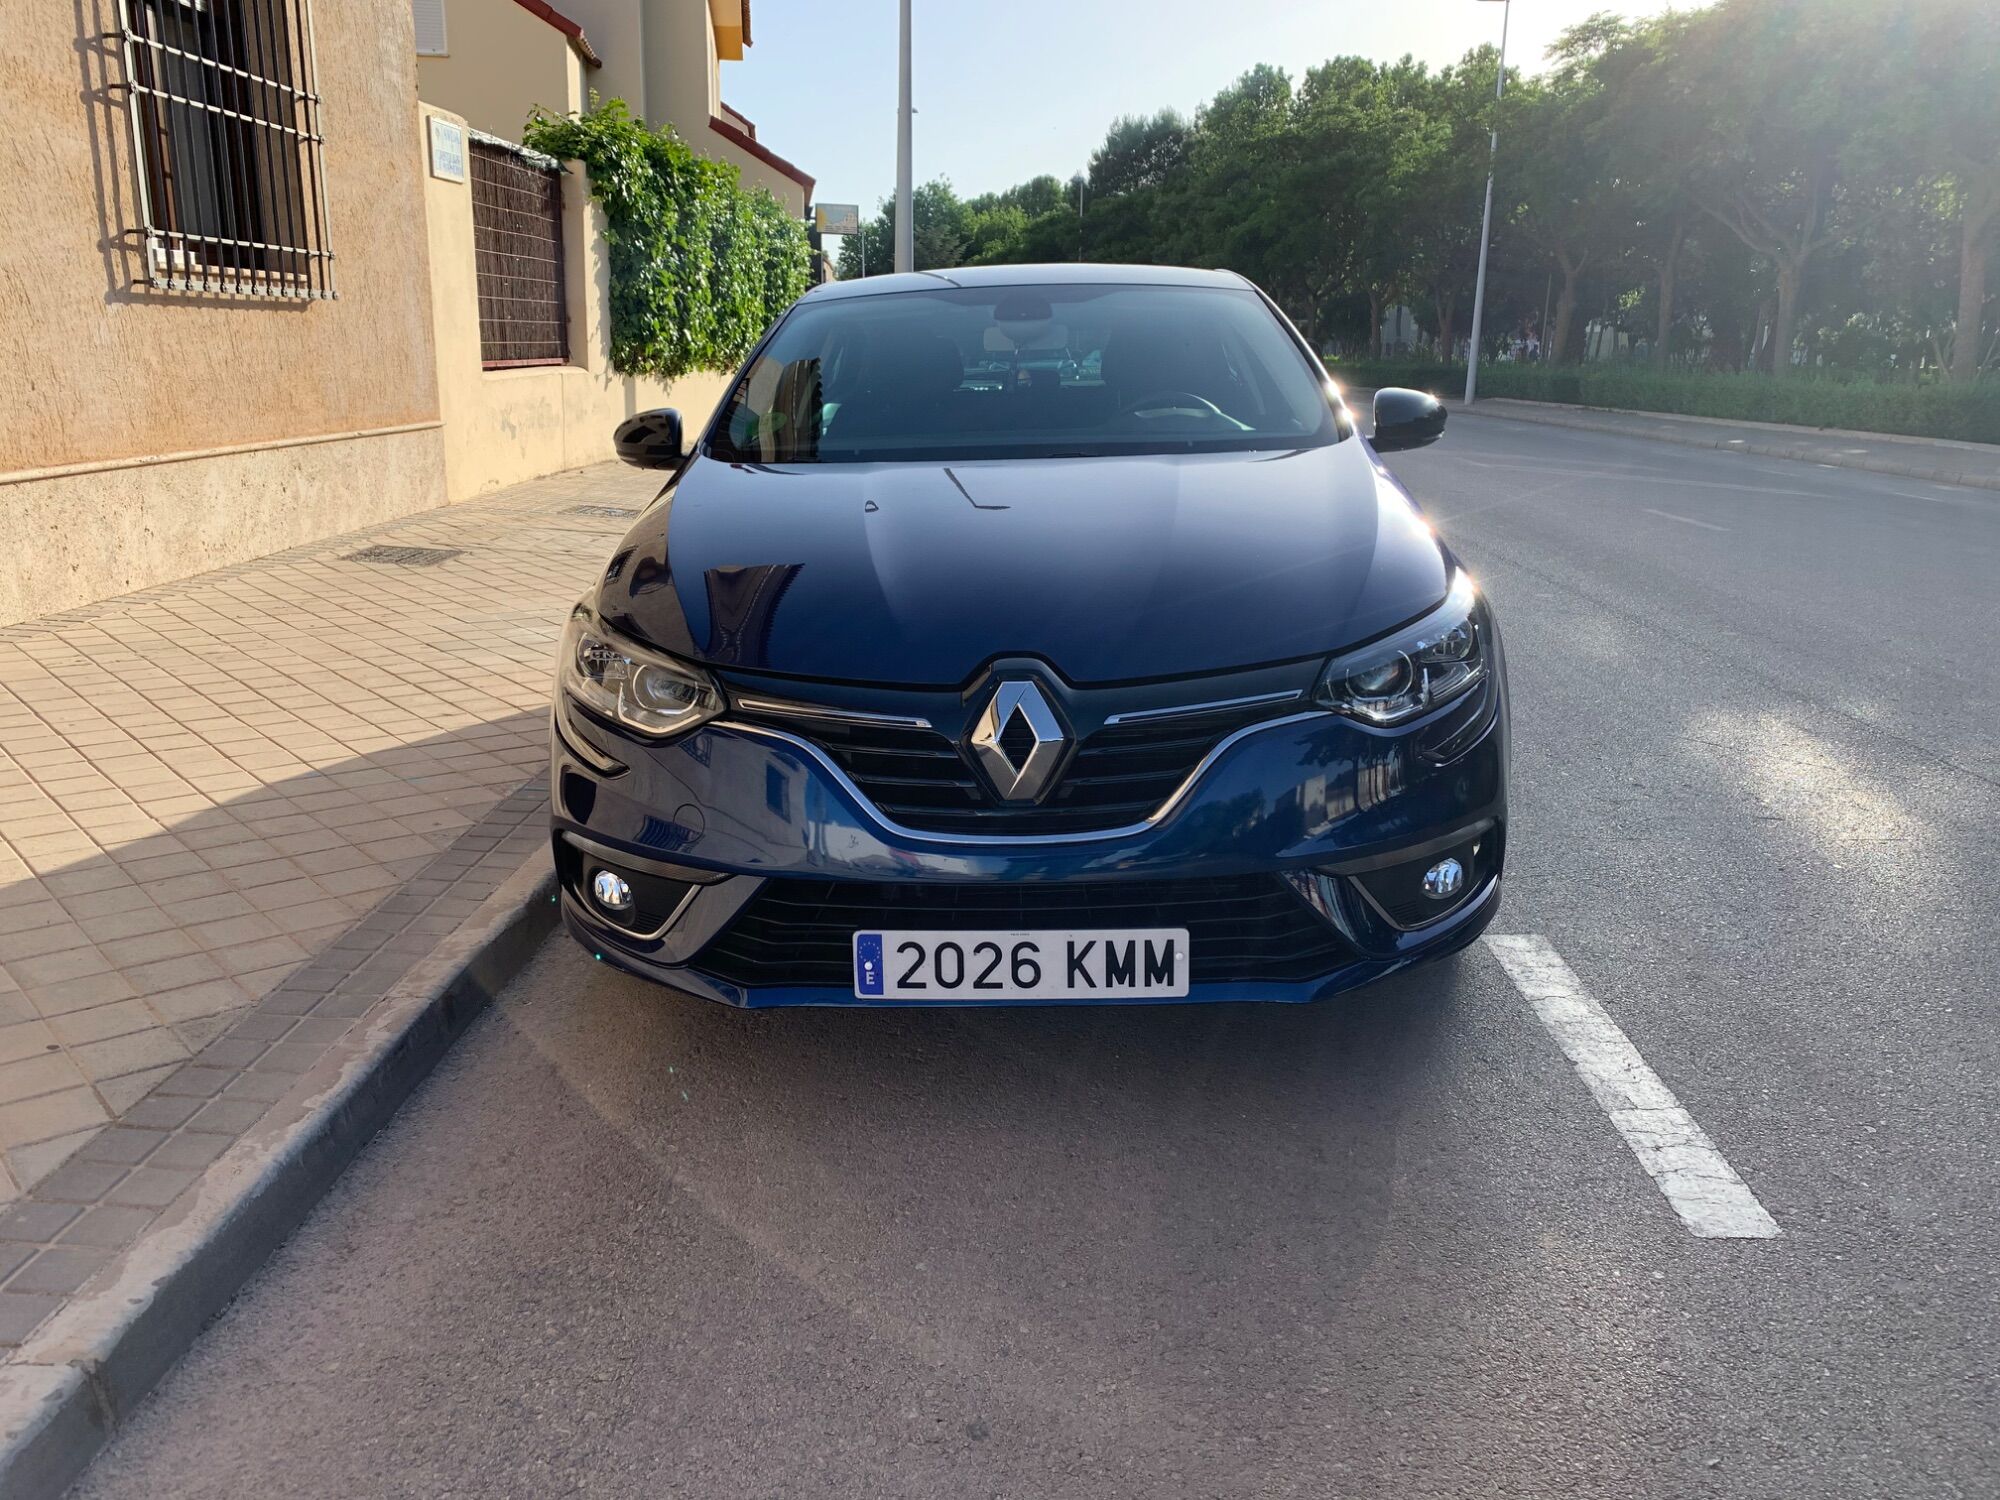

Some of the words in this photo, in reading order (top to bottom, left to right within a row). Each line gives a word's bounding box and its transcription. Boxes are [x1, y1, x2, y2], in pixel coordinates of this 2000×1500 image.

[865, 971, 875, 985] E
[896, 940, 1042, 990] 2026
[1067, 938, 1175, 989] KMM
